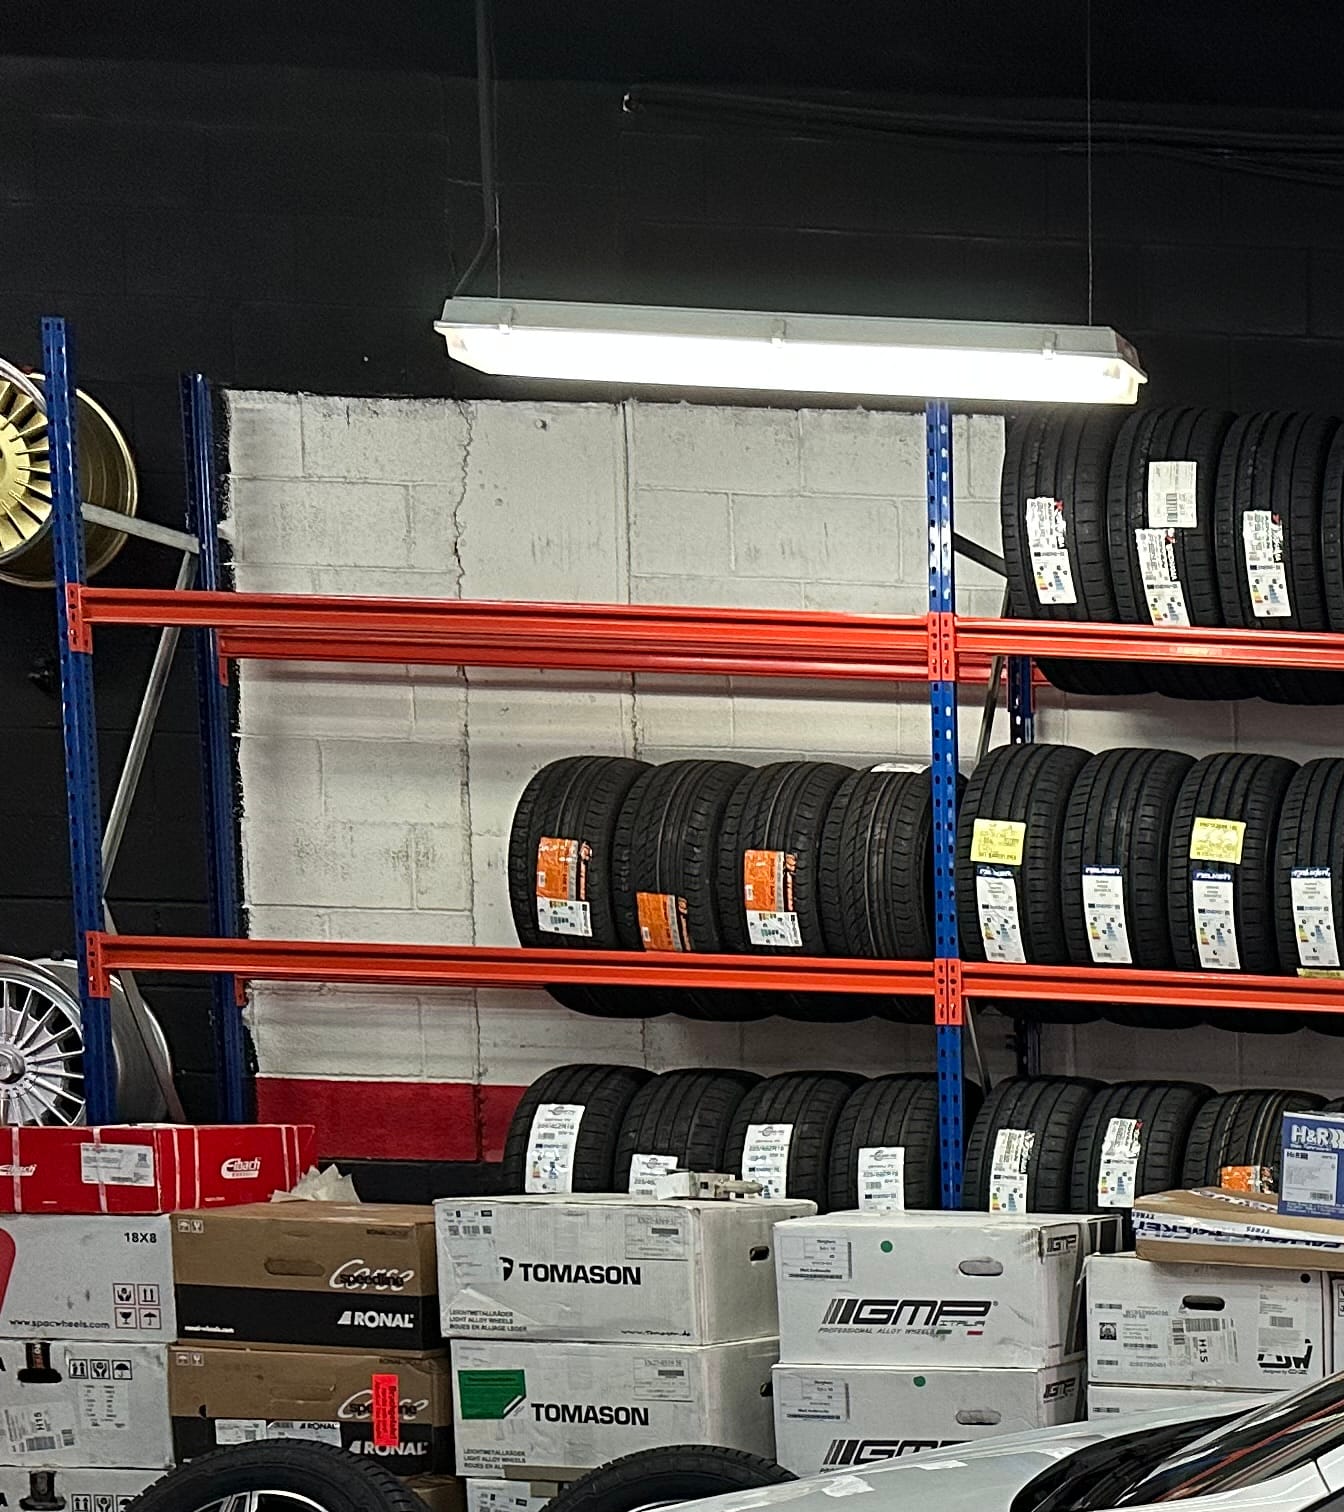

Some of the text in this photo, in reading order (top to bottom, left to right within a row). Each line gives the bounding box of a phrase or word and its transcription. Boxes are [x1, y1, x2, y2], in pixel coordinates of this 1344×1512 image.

[124, 1232, 157, 1244] 18X8
[519, 1262, 642, 1286] TOMASON
[353, 1310, 414, 1329] RONAL
[851, 1298, 993, 1327] GMP
[531, 1402, 649, 1426] TOMASON
